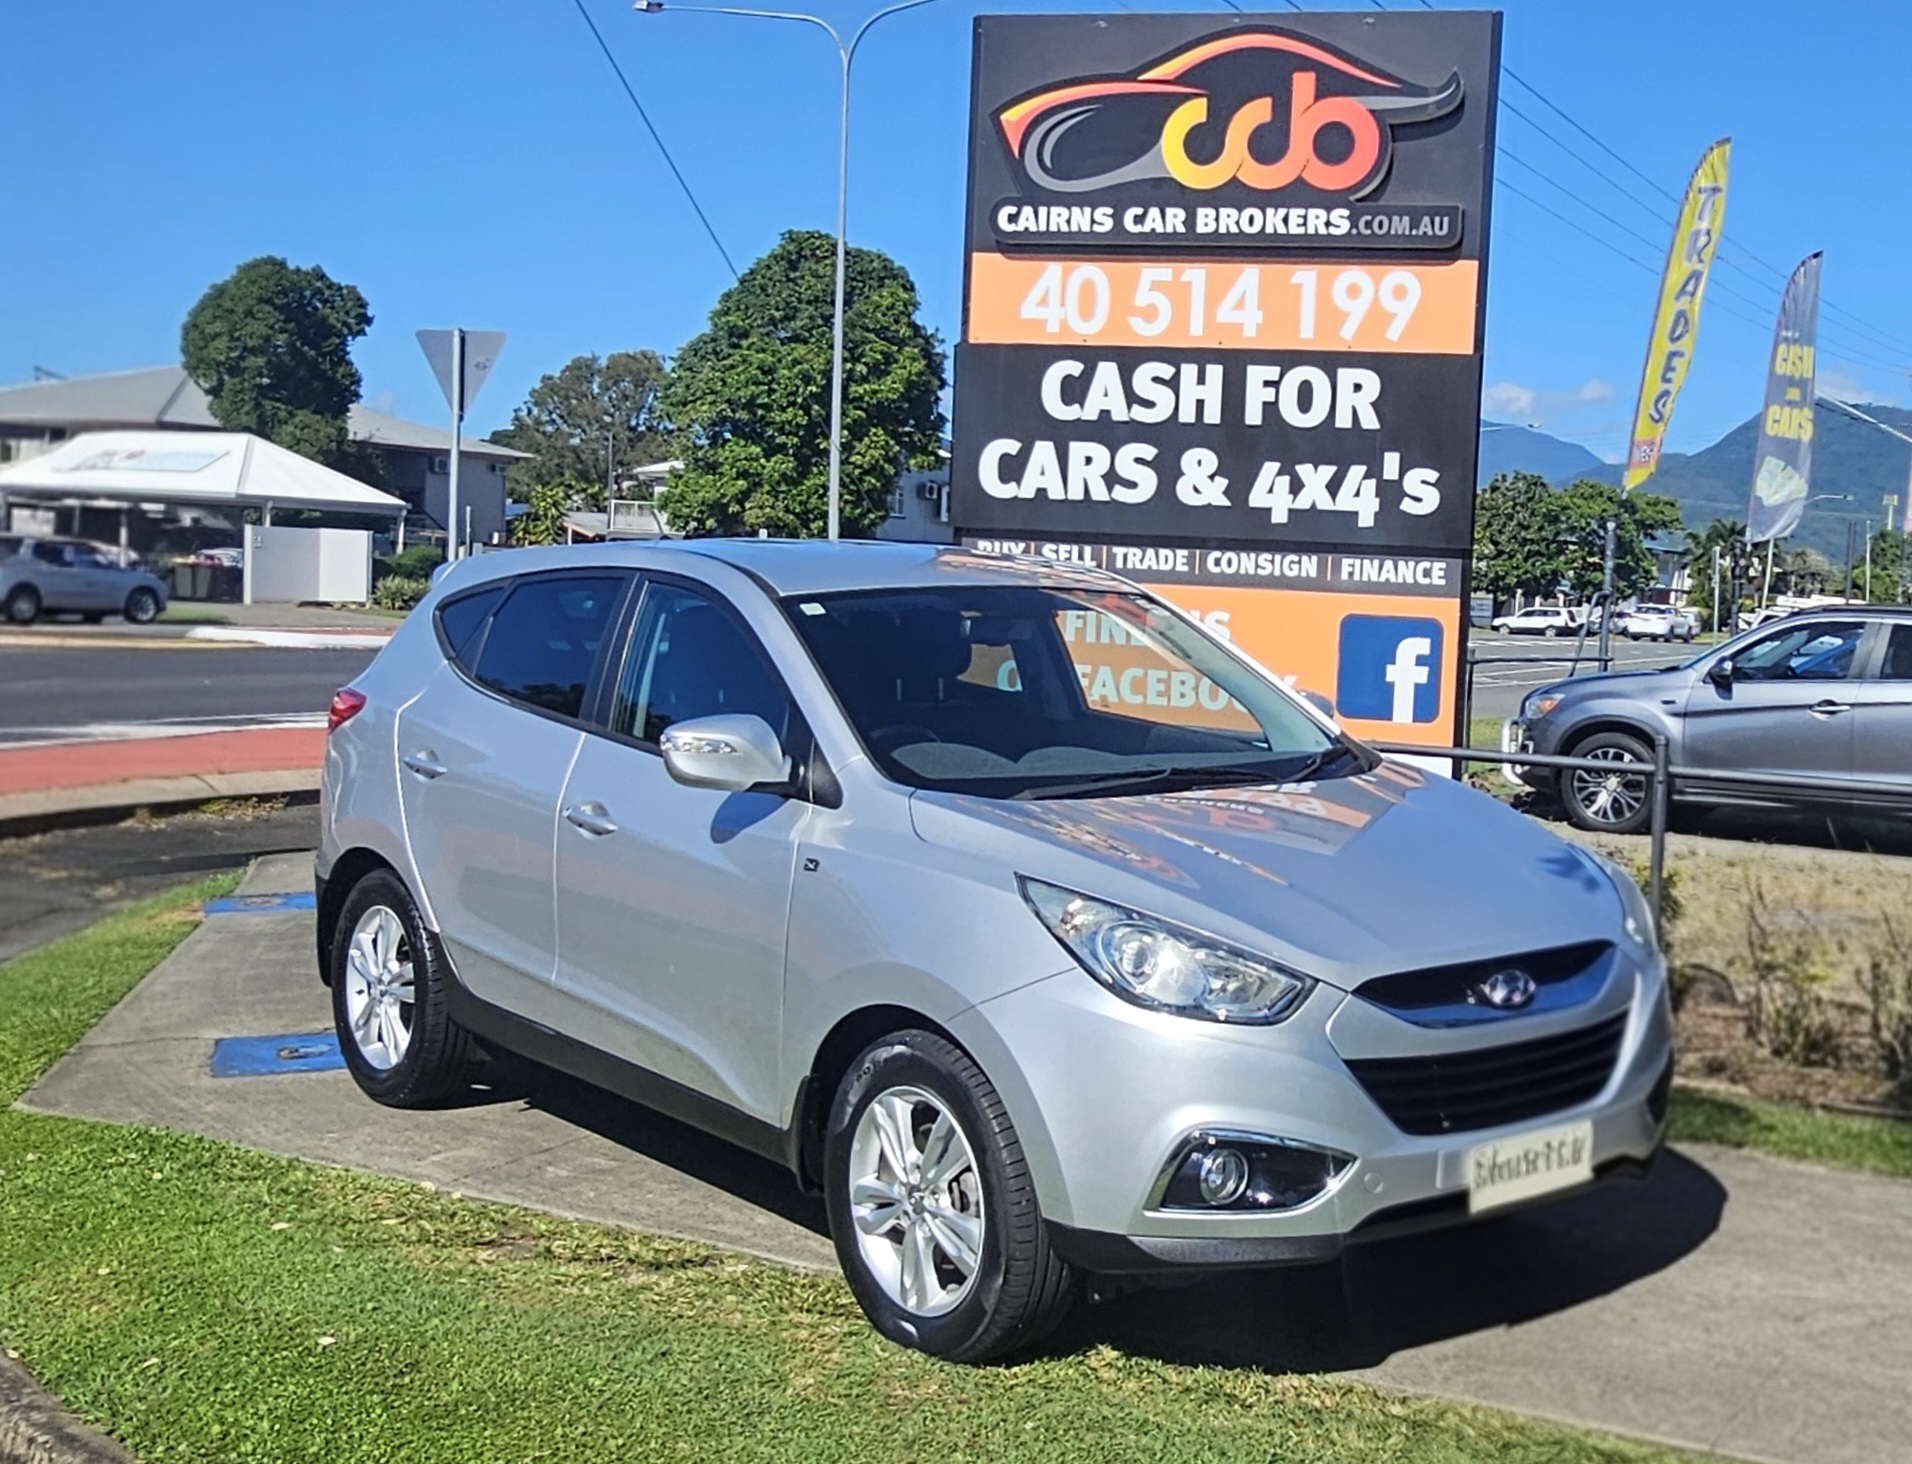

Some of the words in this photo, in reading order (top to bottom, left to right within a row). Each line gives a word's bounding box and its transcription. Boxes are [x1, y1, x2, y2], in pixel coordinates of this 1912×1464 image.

[997, 205, 1114, 233] CAIRNS
[1123, 206, 1186, 234] CAR
[1020, 263, 1110, 335] 40
[1128, 267, 1264, 338] 514
[1290, 268, 1422, 342] 199
[1649, 185, 1723, 424] TRADES
[1041, 359, 1224, 425] CASH
[1244, 365, 1381, 430] FOR
[978, 438, 1159, 504] CARS
[1175, 447, 1231, 507] &
[1042, 543, 1097, 567] SELL
[1112, 549, 1190, 573] TRADE
[1206, 550, 1318, 578] CONSIGN
[1341, 560, 1446, 586] FINANCE
